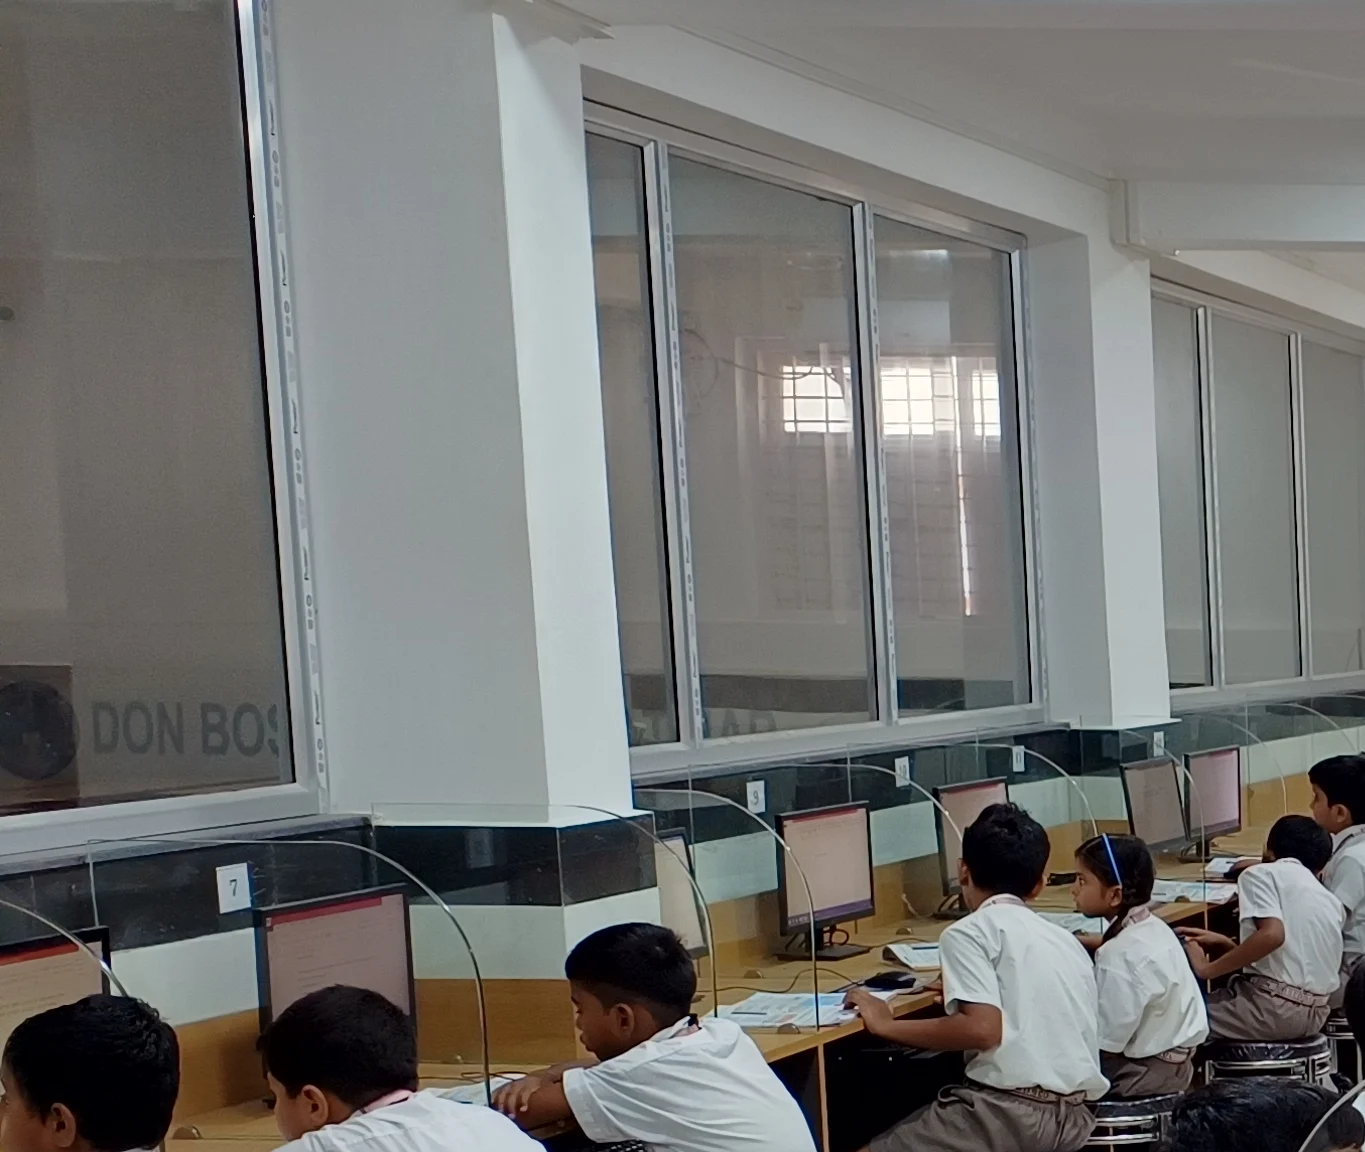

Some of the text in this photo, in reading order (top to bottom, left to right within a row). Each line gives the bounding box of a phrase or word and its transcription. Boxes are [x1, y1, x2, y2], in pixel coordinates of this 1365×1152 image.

[91, 702, 185, 755] DON
[752, 789, 760, 806] 9
[228, 878, 238, 896] 7
